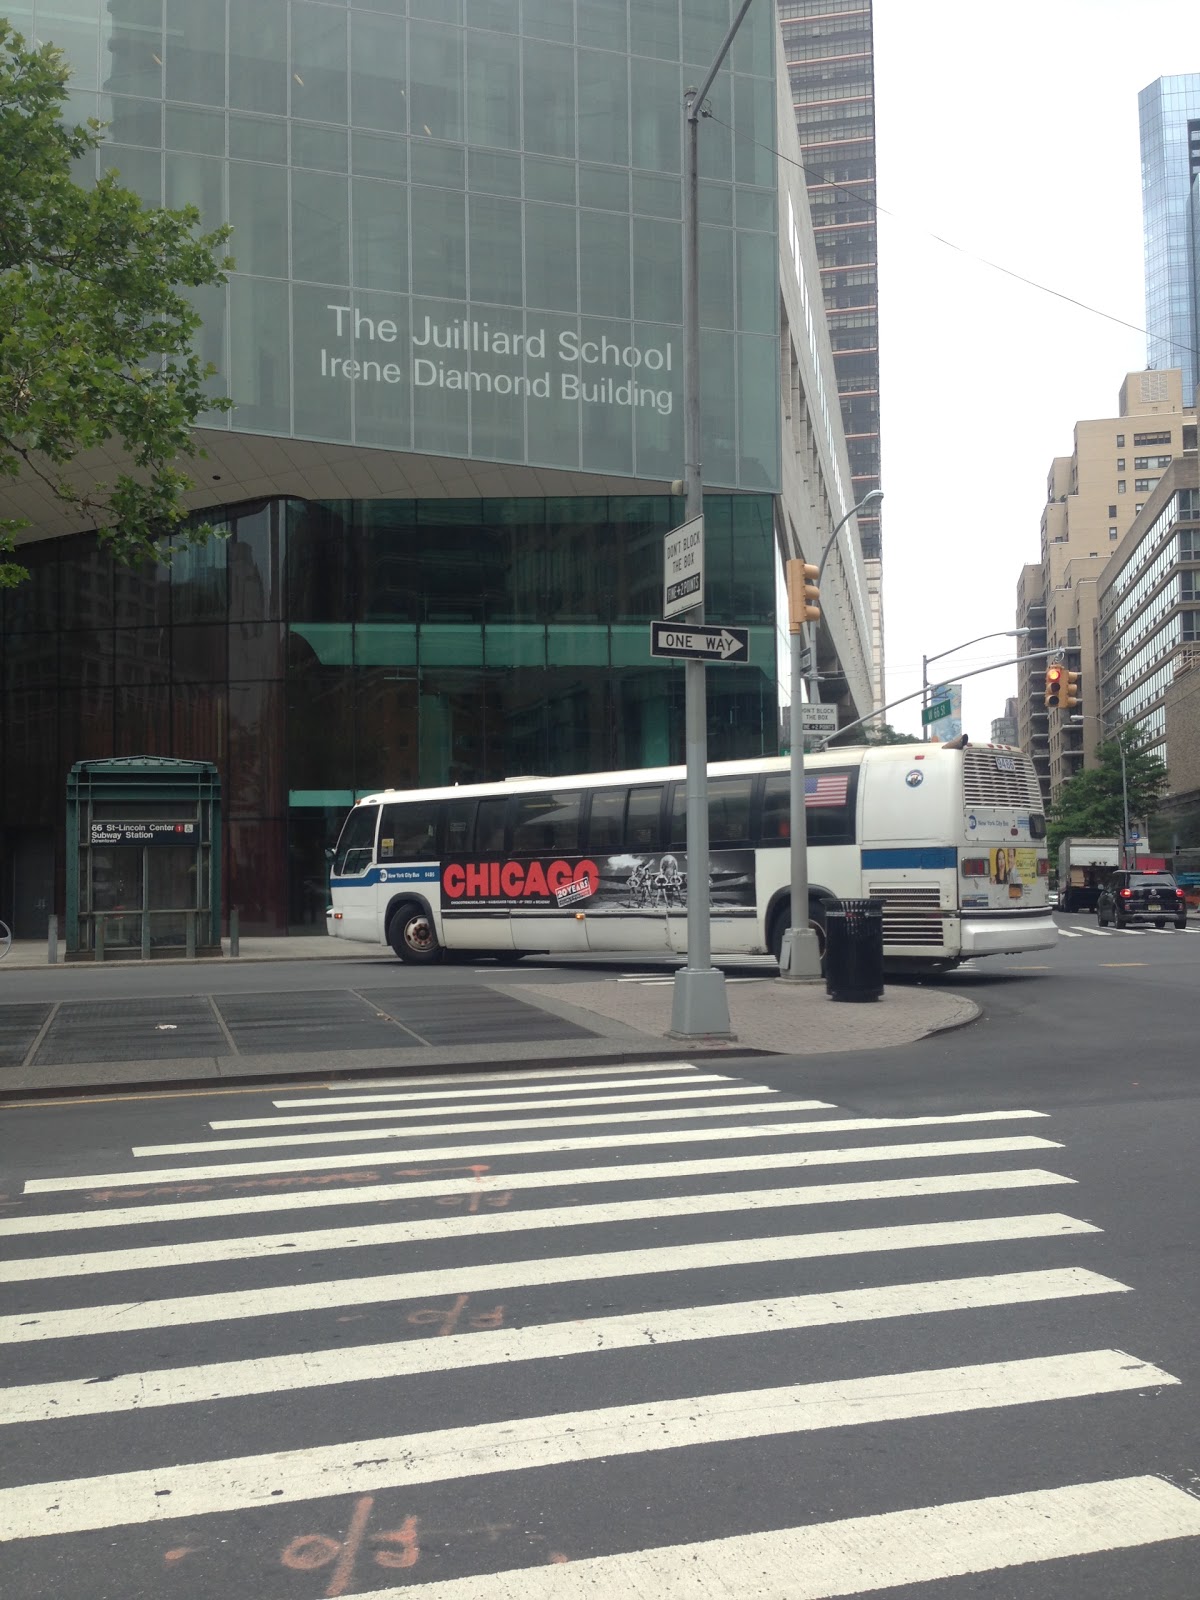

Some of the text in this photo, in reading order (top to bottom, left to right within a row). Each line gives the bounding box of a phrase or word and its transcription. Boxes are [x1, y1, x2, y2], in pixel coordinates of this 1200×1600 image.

[327, 304, 673, 371] The Juilliard School
[320, 348, 673, 415] Irene Diamond Building
[667, 531, 700, 559] DON'T BLOCK
[673, 552, 695, 573] THE BOX
[665, 633, 734, 651] ONE WAY
[927, 709, 933, 721] W
[933, 706, 940, 719] 66
[91, 824, 103, 832] 66
[106, 823, 146, 832] St-Lincoln
[149, 823, 174, 832] Center
[91, 831, 153, 840] Subway Station
[443, 859, 599, 898] CHICAGO
[557, 888, 568, 898] 20
[566, 880, 588, 894] YEARS
